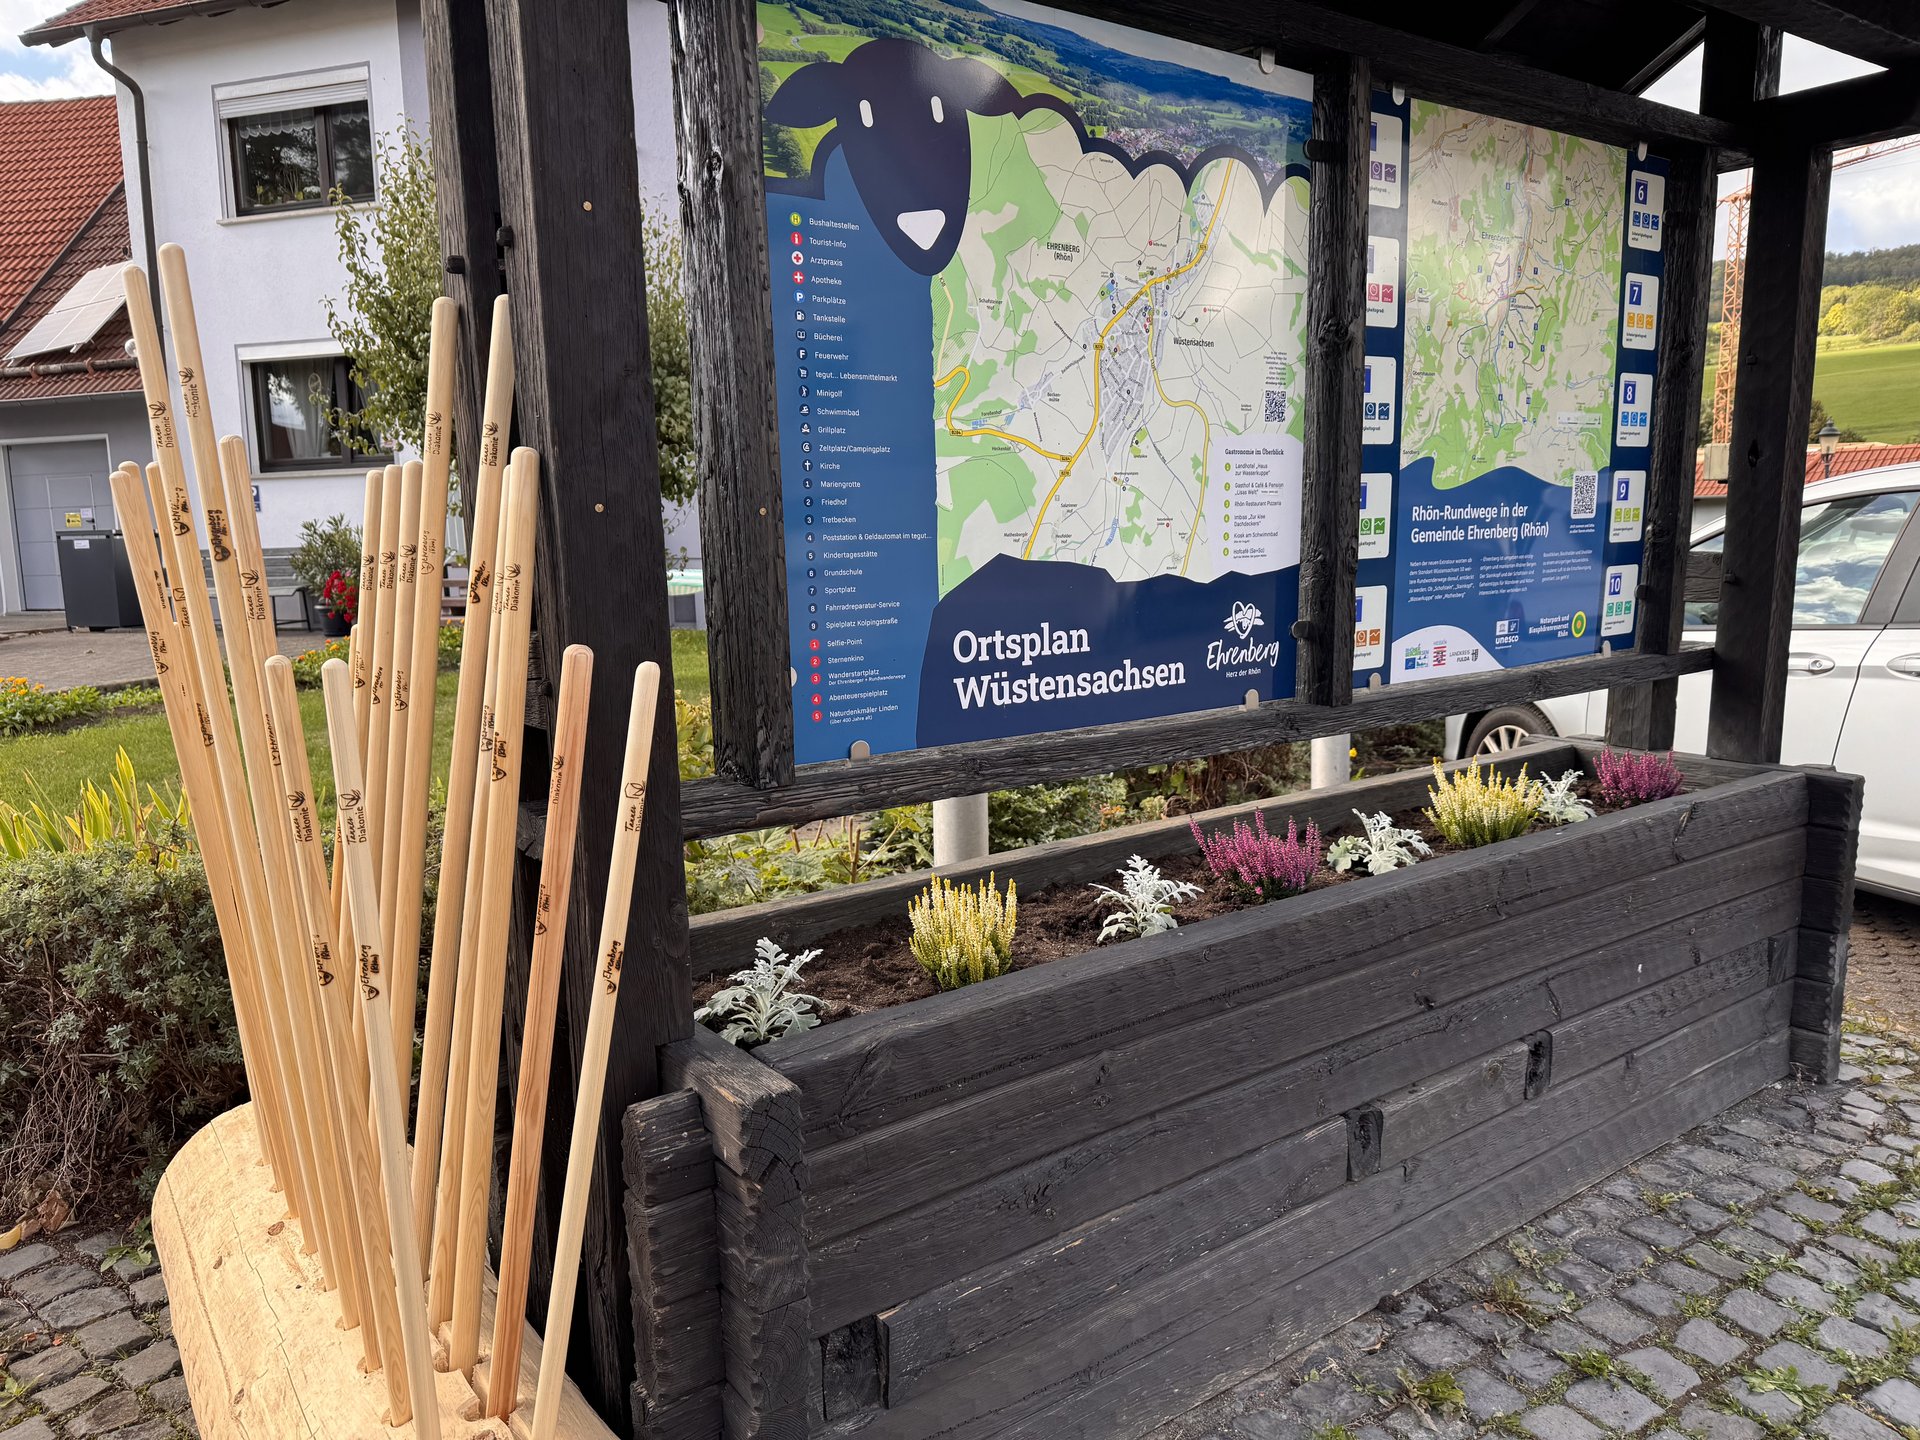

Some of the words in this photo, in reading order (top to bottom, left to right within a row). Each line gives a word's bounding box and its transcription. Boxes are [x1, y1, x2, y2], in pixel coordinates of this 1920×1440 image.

[1638, 186, 1644, 200] 6
[809, 218, 859, 230] Bushaltestellen
[809, 237, 847, 248] Tourist-Info
[1481, 231, 1510, 244] Ehrenberg
[1047, 242, 1080, 253] EHRENBERG
[810, 256, 843, 267] Arztpraxis
[1054, 251, 1073, 262] (Rhön)
[811, 276, 842, 286] Apotheke
[796, 293, 803, 301] P
[812, 295, 846, 305] Parkplätze
[1633, 287, 1638, 301] 7
[813, 314, 845, 323] Tankstelle
[814, 333, 843, 342] Bücherei
[1174, 337, 1214, 347] Wüstensachsen
[800, 350, 805, 358] F
[815, 352, 849, 360] Feuerwehr
[840, 373, 898, 382] Lebensmittelmarkt
[817, 389, 842, 398] Minigolf
[1626, 385, 1632, 400] 8
[817, 408, 859, 416] Schwimmbad
[162, 417, 174, 448] Diakonie
[818, 426, 846, 434] Grillplatz
[433, 426, 442, 455] Diakonie
[489, 436, 499, 467] Diakonie
[819, 444, 891, 453] Zeltplatz/Campingplatz
[1262, 448, 1284, 456] Überblick
[820, 462, 840, 470] Kirche
[821, 481, 860, 489] Mariengrotte
[1620, 483, 1626, 497] 9
[1412, 504, 1497, 524] Rhön-Rundwege
[1500, 504, 1509, 517] in
[1512, 504, 1528, 518] der
[1411, 527, 1464, 543] Gemeinde
[1467, 524, 1519, 542] Ehrenberg
[1521, 521, 1549, 540] (Rhön)
[824, 551, 877, 559] Kindertagesstätte
[406, 557, 417, 583] Diakonie
[366, 566, 374, 590] Diakonie
[387, 563, 395, 589] Diakonie
[825, 586, 856, 594] Sportplatz
[1610, 577, 1621, 592] 10
[510, 579, 520, 611] Diakonie
[826, 601, 900, 611] Fahrradreparatur-Service
[826, 621, 856, 629] Spielplatz
[858, 618, 898, 627] Kolpingstraße
[1540, 616, 1560, 624] Naturpark
[1529, 623, 1569, 634] Biosphärenreservat
[827, 639, 862, 647] Selfie-Point
[953, 622, 1090, 666] Ortsplan
[1495, 635, 1518, 644] unesco
[828, 656, 864, 664] Sternenkino
[1206, 638, 1280, 671] Ehrenberg
[828, 669, 879, 679] Wanderstartplatz
[1226, 671, 1238, 679] Herz
[1239, 669, 1248, 677] der
[1248, 667, 1261, 675] Rhön
[953, 659, 1185, 710] Wüstensachsen
[829, 690, 888, 701] Abenteuerspielplatz
[830, 707, 877, 717] Naturdenkmäler
[879, 704, 898, 712] Linden
[625, 805, 636, 831] Tanner
[300, 807, 313, 842] Diakonie
[355, 806, 367, 843] Diakonie
[346, 817, 356, 845] Tanner
[360, 945, 371, 983] Ehrenberg
[603, 940, 621, 978] Ehrenberg
